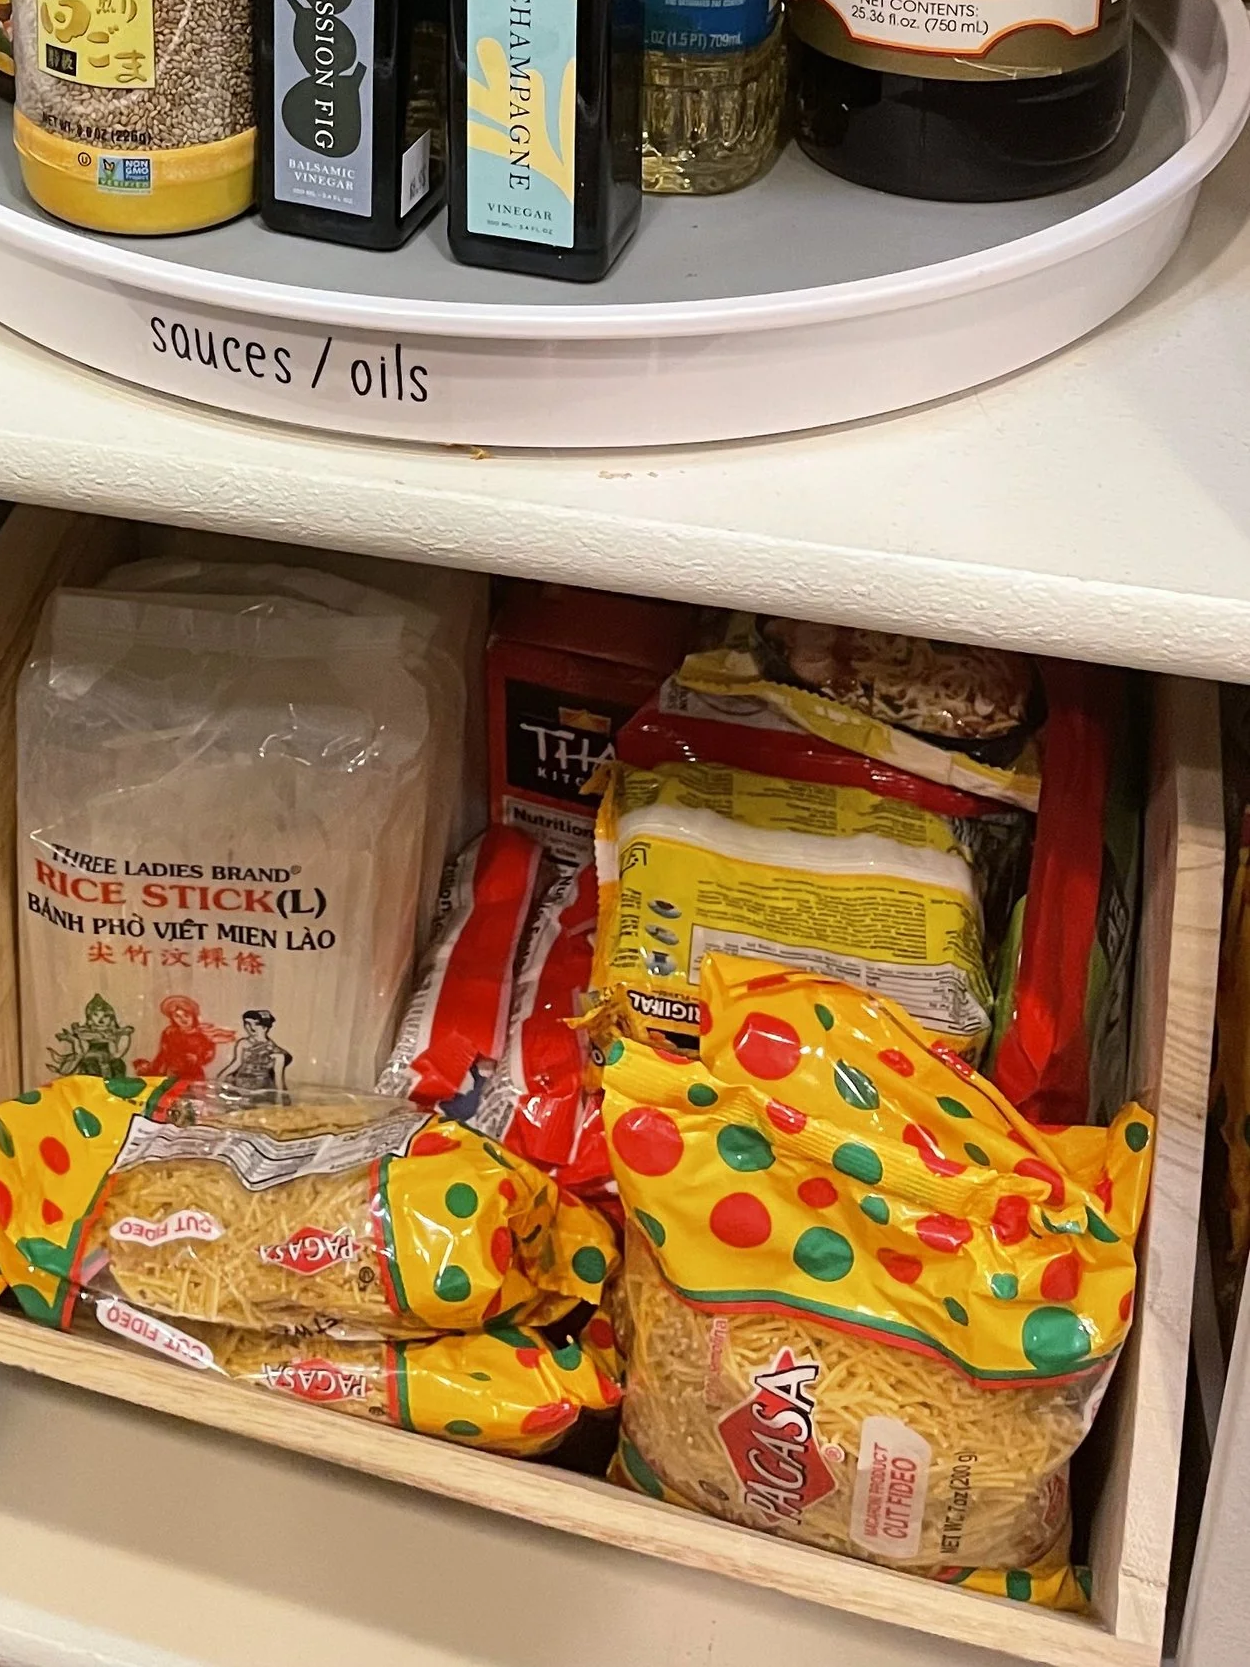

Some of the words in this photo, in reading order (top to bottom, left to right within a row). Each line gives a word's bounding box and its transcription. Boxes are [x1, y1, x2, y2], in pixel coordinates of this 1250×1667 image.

[851, 5, 885, 24] 25.36
[924, 18, 957, 33] (750
[960, 20, 989, 35] mL)
[314, 98, 334, 151] FIG
[126, 160, 148, 168] NON
[126, 167, 149, 175] GMO
[288, 158, 356, 179] BALSAMIC
[294, 171, 354, 191] VINEGAR
[487, 203, 552, 221] VINEGAR
[150, 316, 292, 384] sauces
[350, 343, 428, 402] oils
[51, 843, 117, 875] THREE
[124, 860, 203, 878] LADIES
[212, 866, 290, 882] BRAND
[35, 858, 126, 905] RICE
[142, 883, 327, 919] STICK(L)
[287, 927, 335, 951] LÀO
[118, 1221, 168, 1241] FIDEO
[174, 1215, 214, 1234] CUT
[258, 1235, 358, 1263] PAGASA
[107, 1305, 159, 1341] FIDEO
[262, 1363, 366, 1400] PAGASA
[744, 1364, 820, 1526] PAGASA
[870, 1442, 889, 1494] PRODUCT
[889, 1456, 917, 1504] FIDEO
[882, 1507, 908, 1539] CUT
